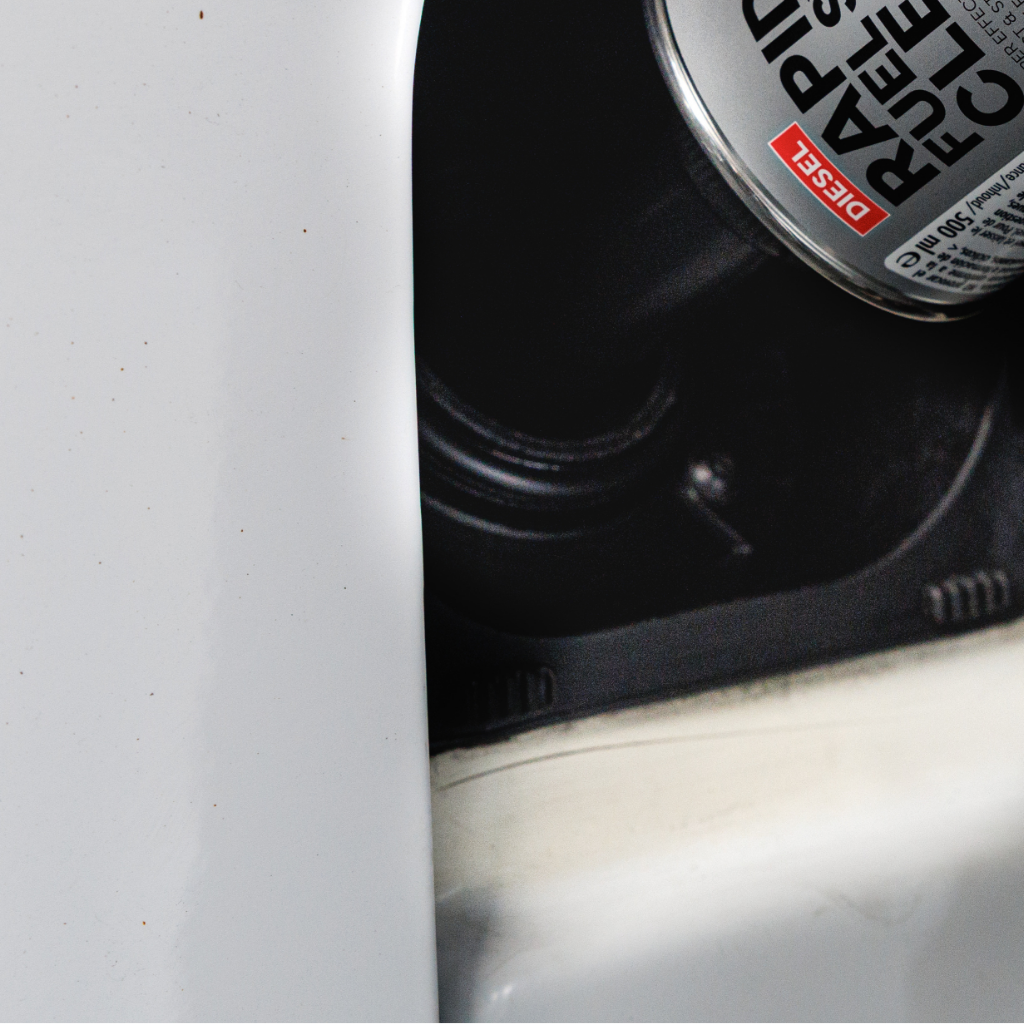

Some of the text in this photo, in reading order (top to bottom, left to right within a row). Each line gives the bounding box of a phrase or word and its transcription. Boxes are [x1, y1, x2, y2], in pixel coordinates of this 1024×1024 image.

[1000, 10, 1017, 27] &
[844, 14, 985, 167] FUEL
[789, 138, 870, 222] DIESEL
[933, 210, 977, 239] 500
[913, 233, 948, 255] ml
[934, 251, 952, 262] de
